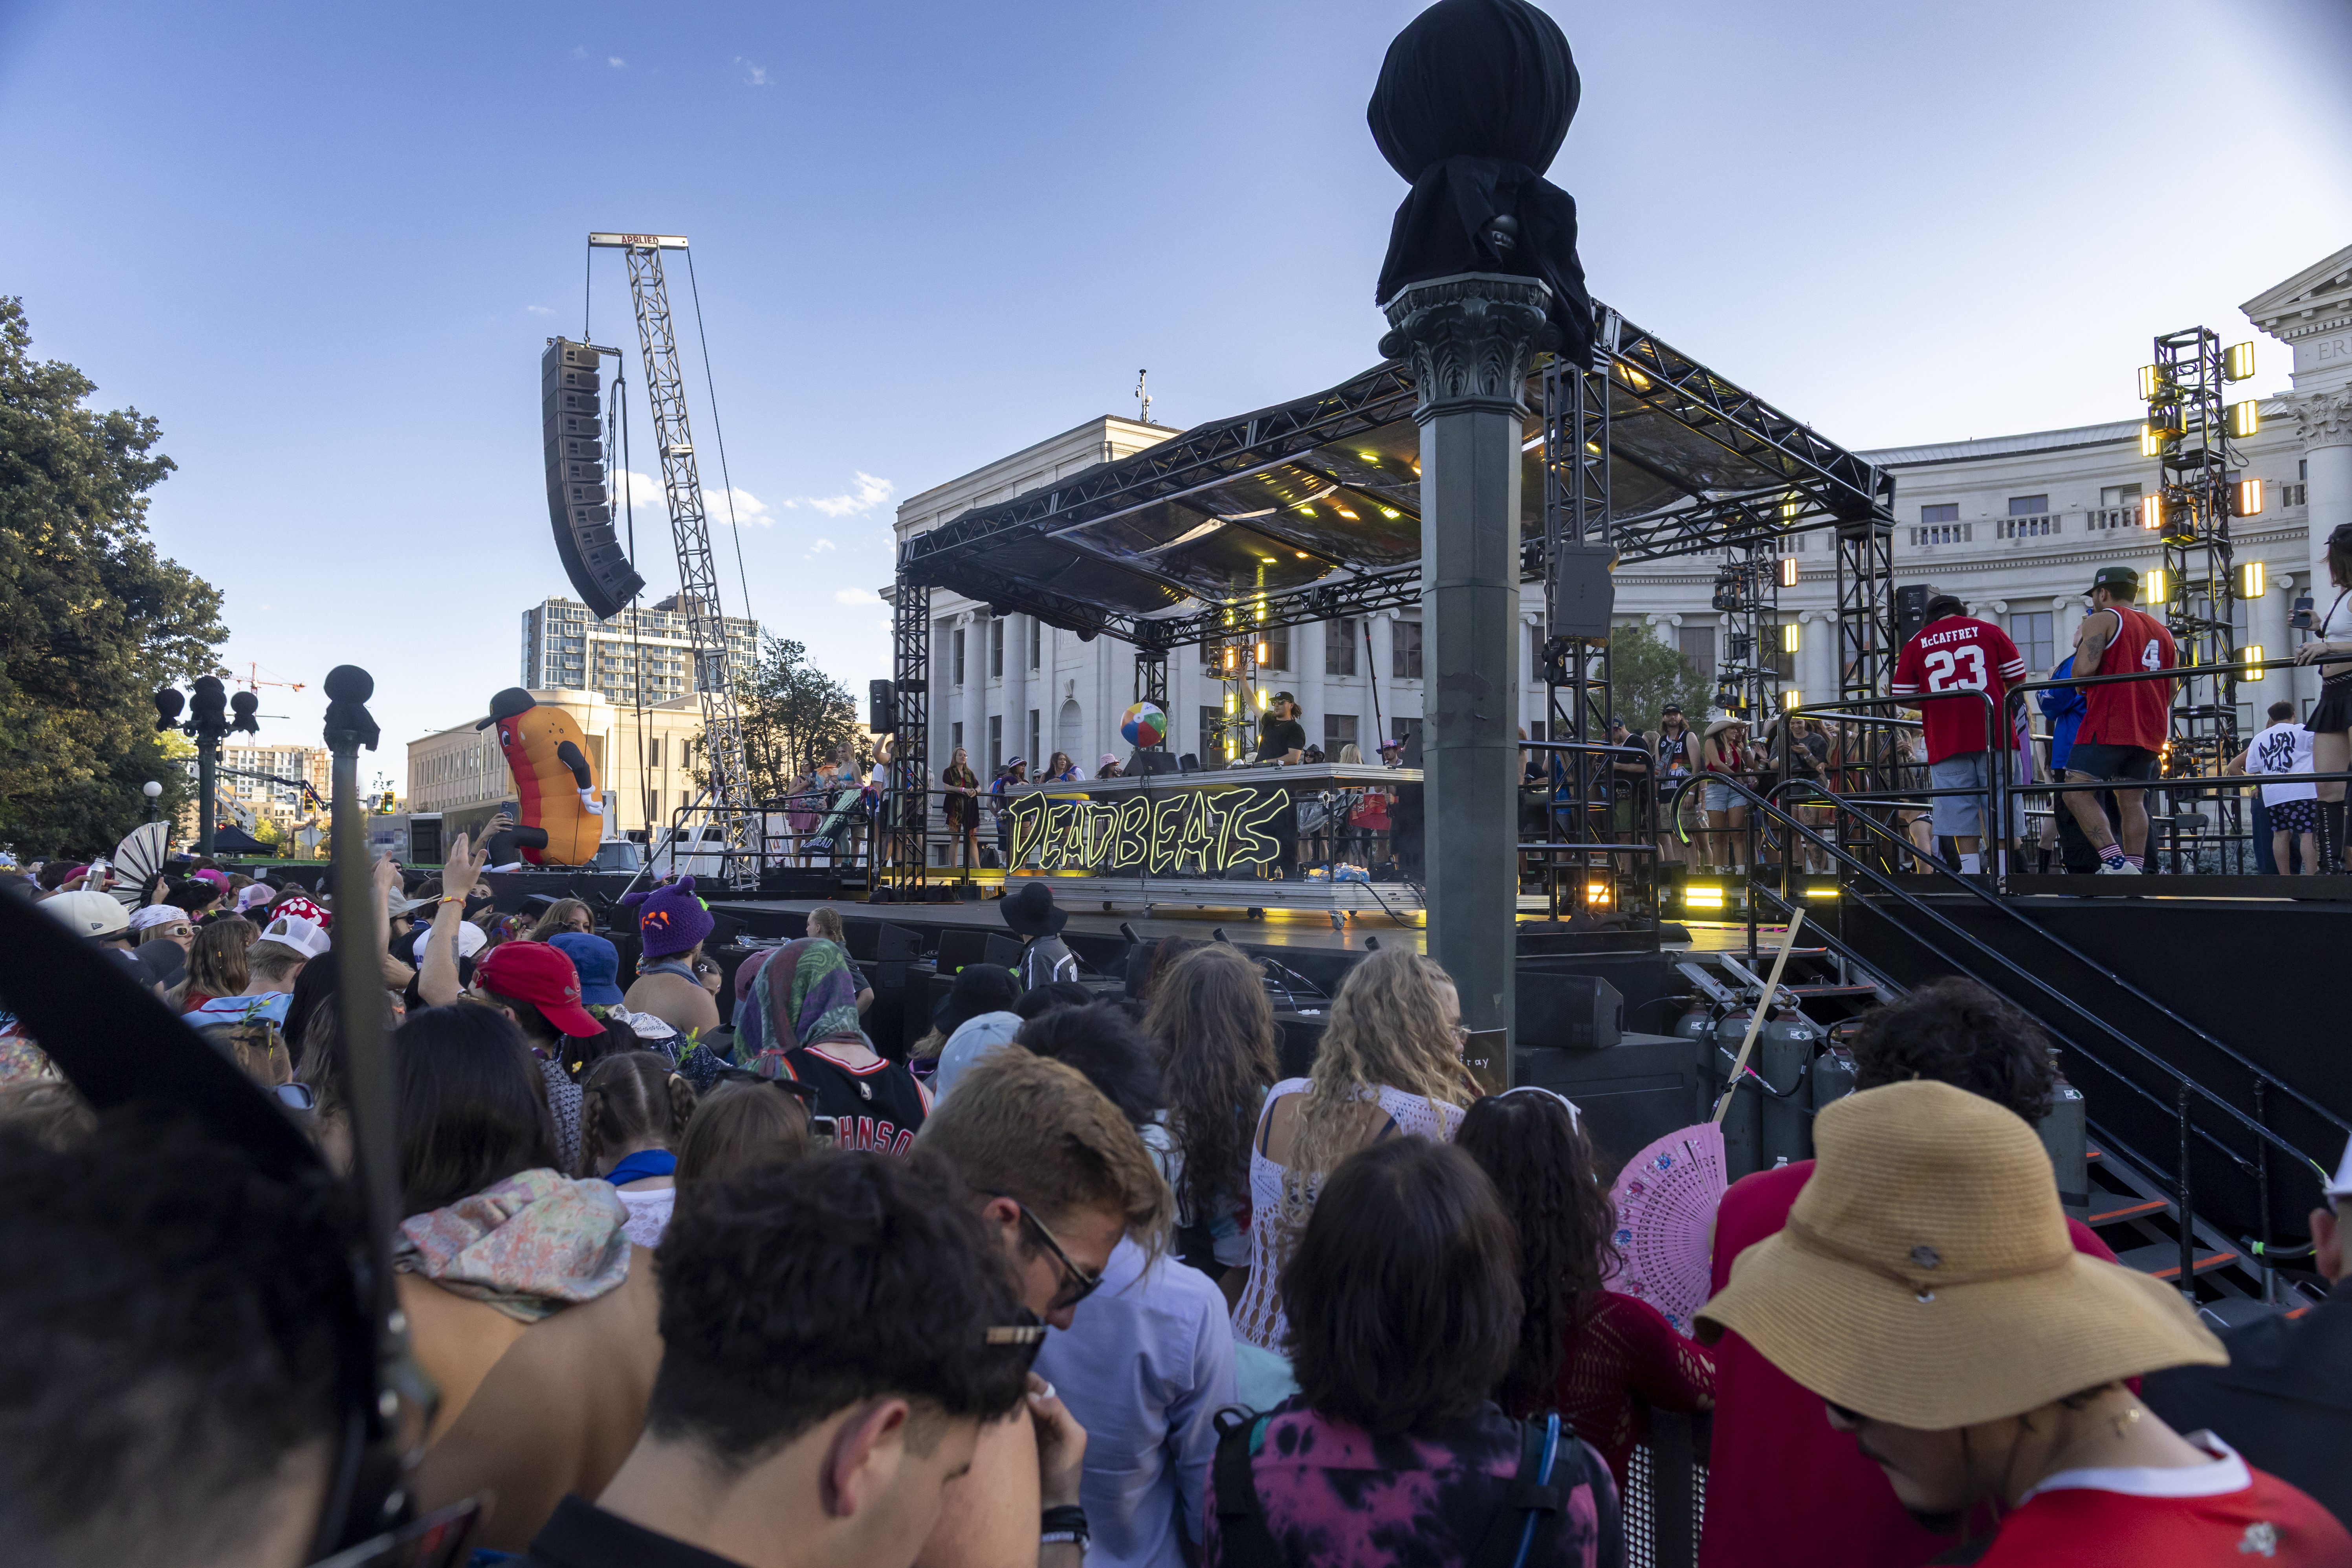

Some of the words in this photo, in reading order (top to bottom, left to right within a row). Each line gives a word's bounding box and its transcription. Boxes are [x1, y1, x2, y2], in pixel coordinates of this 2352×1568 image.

[621, 235, 659, 244] APPLIED
[1920, 627, 1978, 648] McCAFFREY
[2141, 639, 2161, 671] 4
[1924, 645, 1987, 693] 23
[1008, 787, 1290, 874] DEADBEATS
[838, 1115, 915, 1161] HNSO
